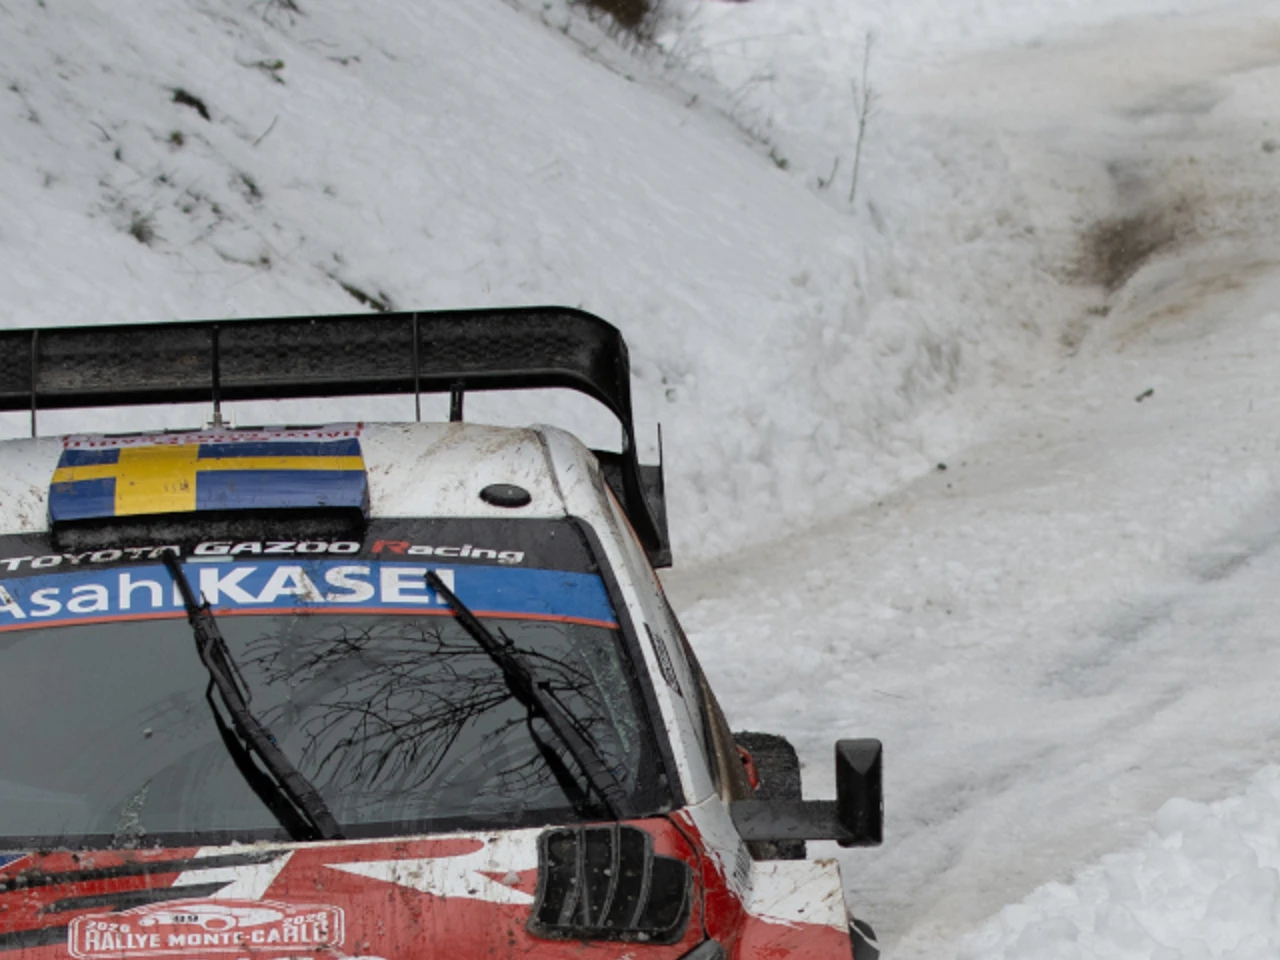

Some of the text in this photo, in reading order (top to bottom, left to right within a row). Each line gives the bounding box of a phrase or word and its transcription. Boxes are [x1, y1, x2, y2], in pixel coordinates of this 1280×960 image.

[0, 540, 525, 572] TOYOTA GAZOO Racing
[200, 565, 455, 606] KASEI
[85, 929, 161, 952] RALLYE
